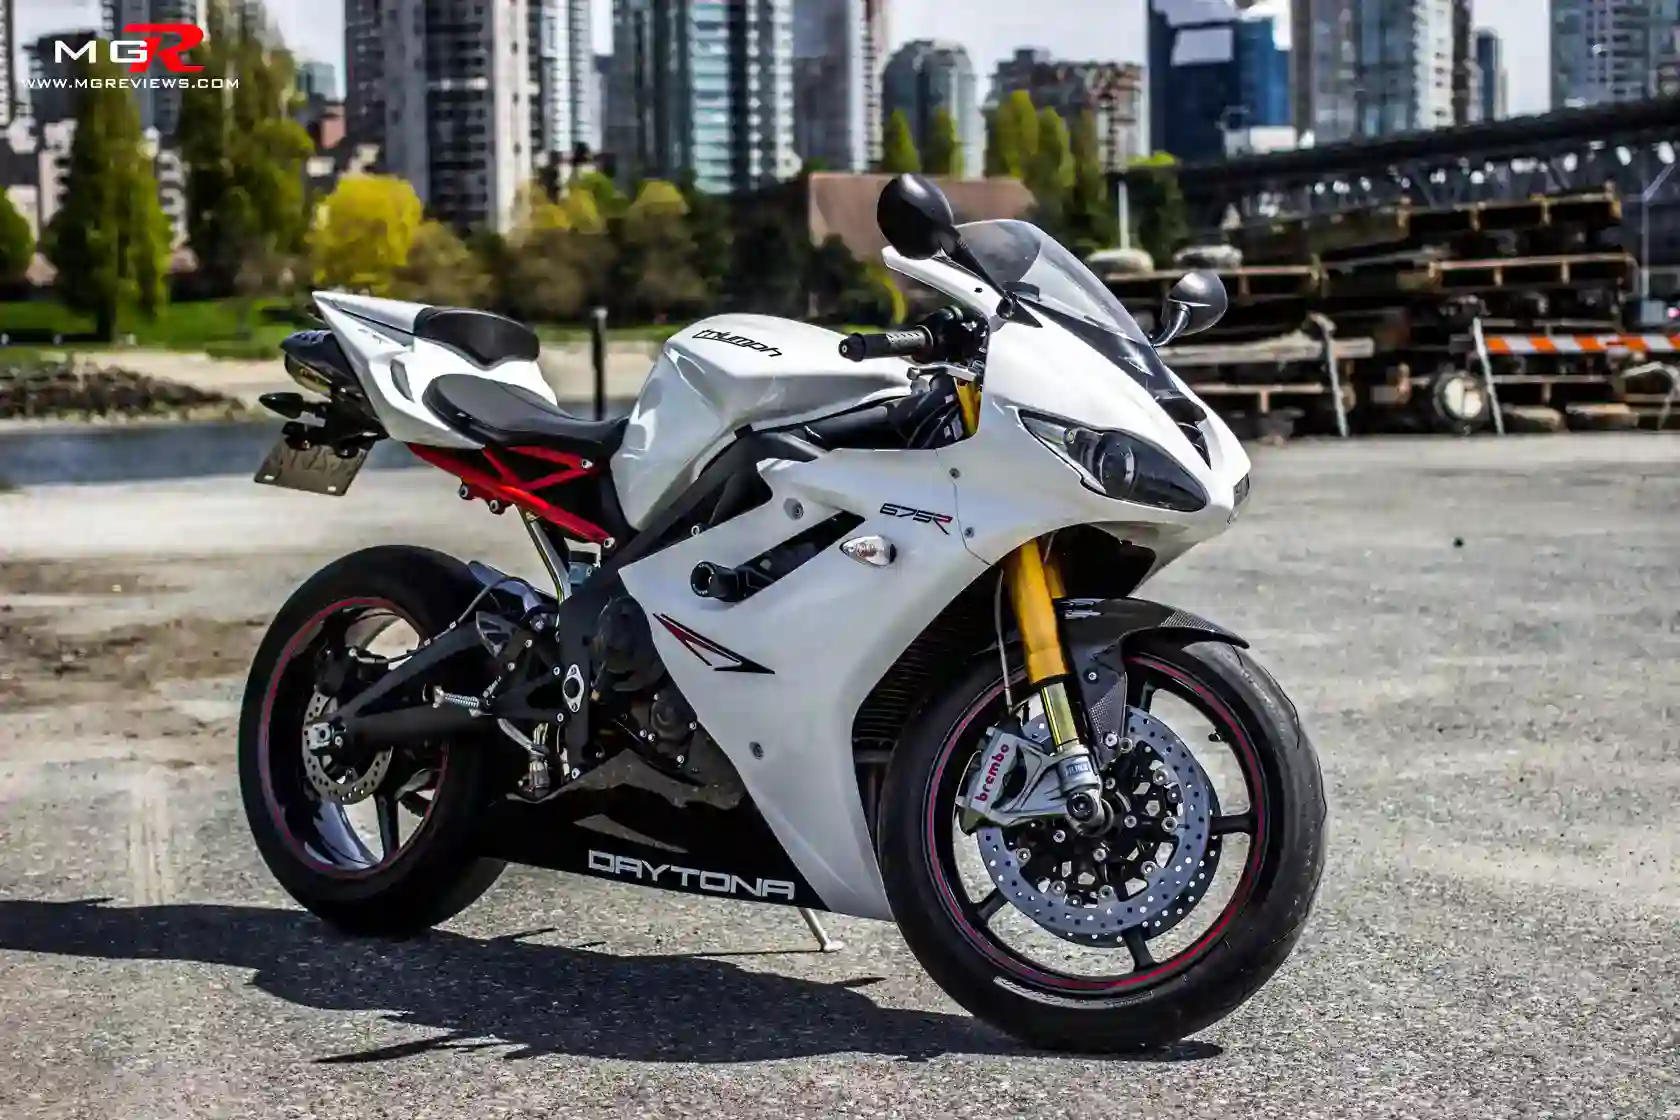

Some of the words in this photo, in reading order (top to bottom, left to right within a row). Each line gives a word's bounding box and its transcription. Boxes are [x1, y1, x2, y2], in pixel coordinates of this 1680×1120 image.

[880, 503, 953, 535] 675R
[974, 743, 1010, 802] brembo
[588, 849, 795, 900] DAYTONA
